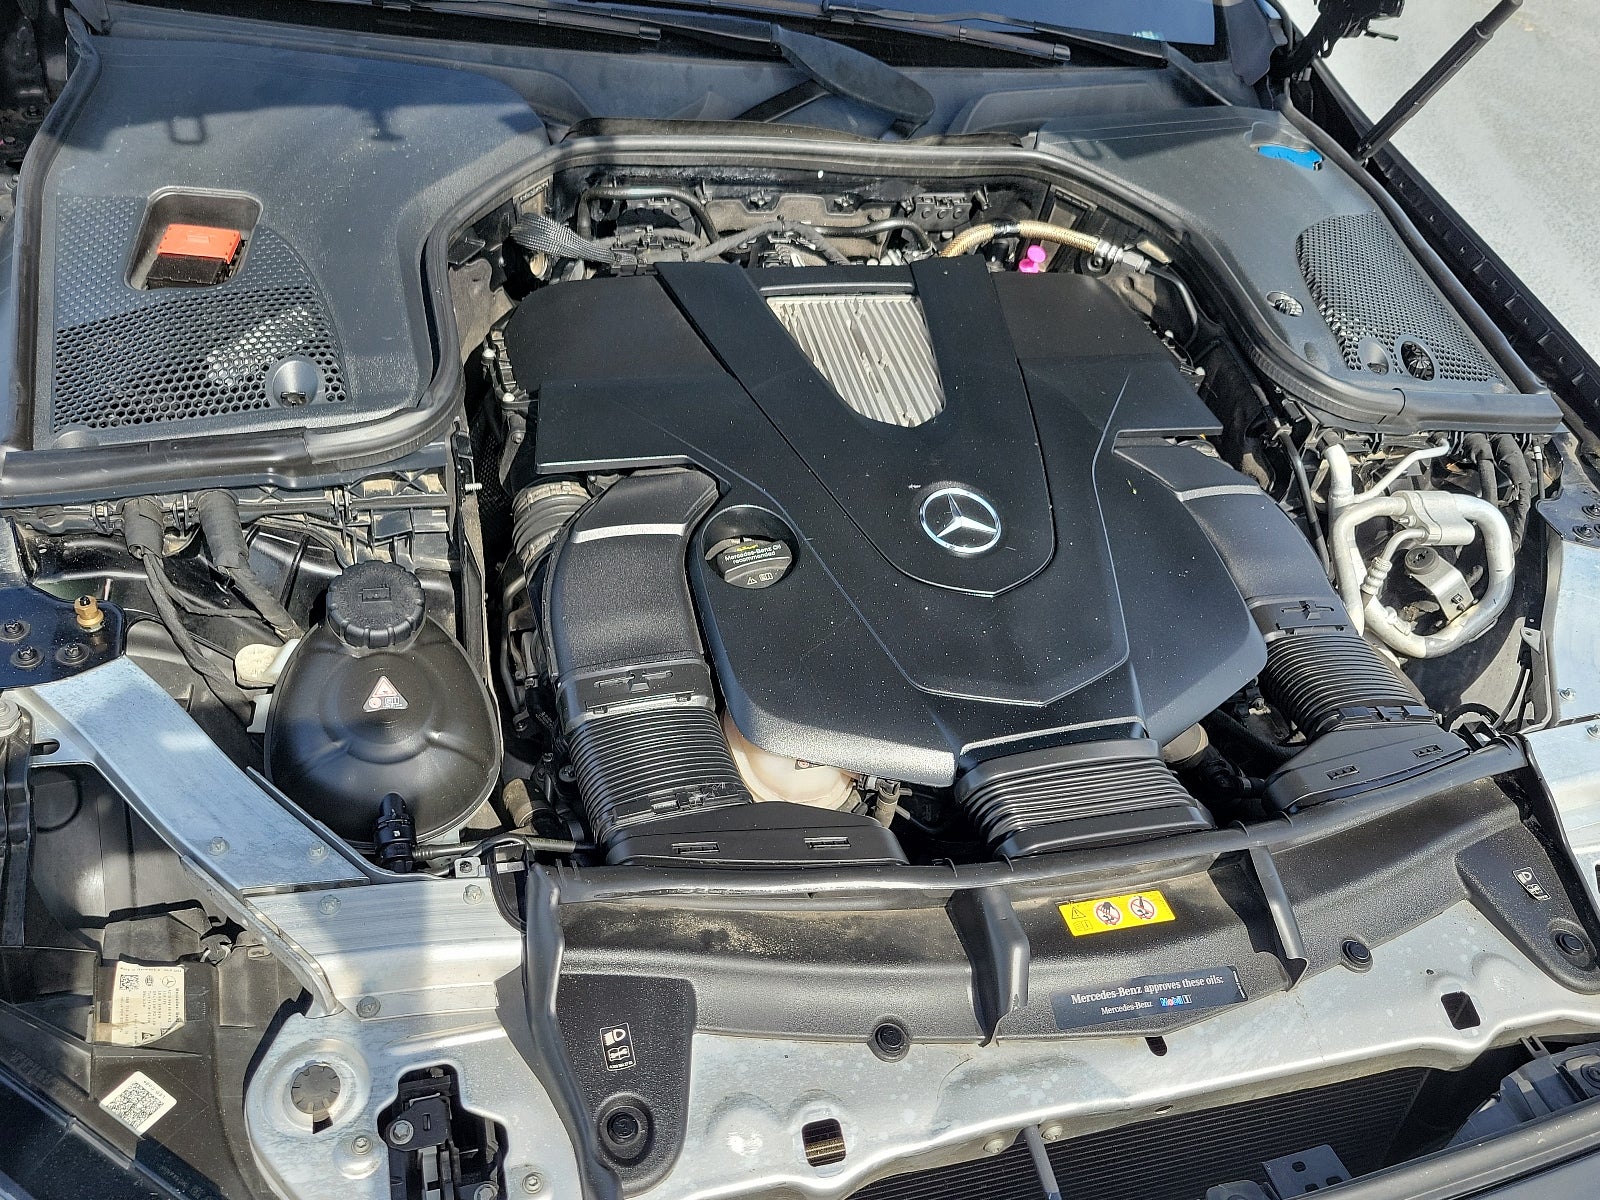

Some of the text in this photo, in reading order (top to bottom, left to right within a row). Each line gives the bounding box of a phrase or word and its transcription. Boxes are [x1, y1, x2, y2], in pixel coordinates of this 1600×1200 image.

[725, 547, 772, 562] Mercedes-Benz
[733, 551, 776, 564] recommended
[1071, 986, 1143, 1005] Mercedes-Benz
[1144, 980, 1181, 995] approves
[1182, 978, 1205, 988] these
[1205, 974, 1225, 985] oils:
[1101, 1001, 1153, 1016] Mercedes-Benz
[1160, 995, 1183, 1006] Mobil
